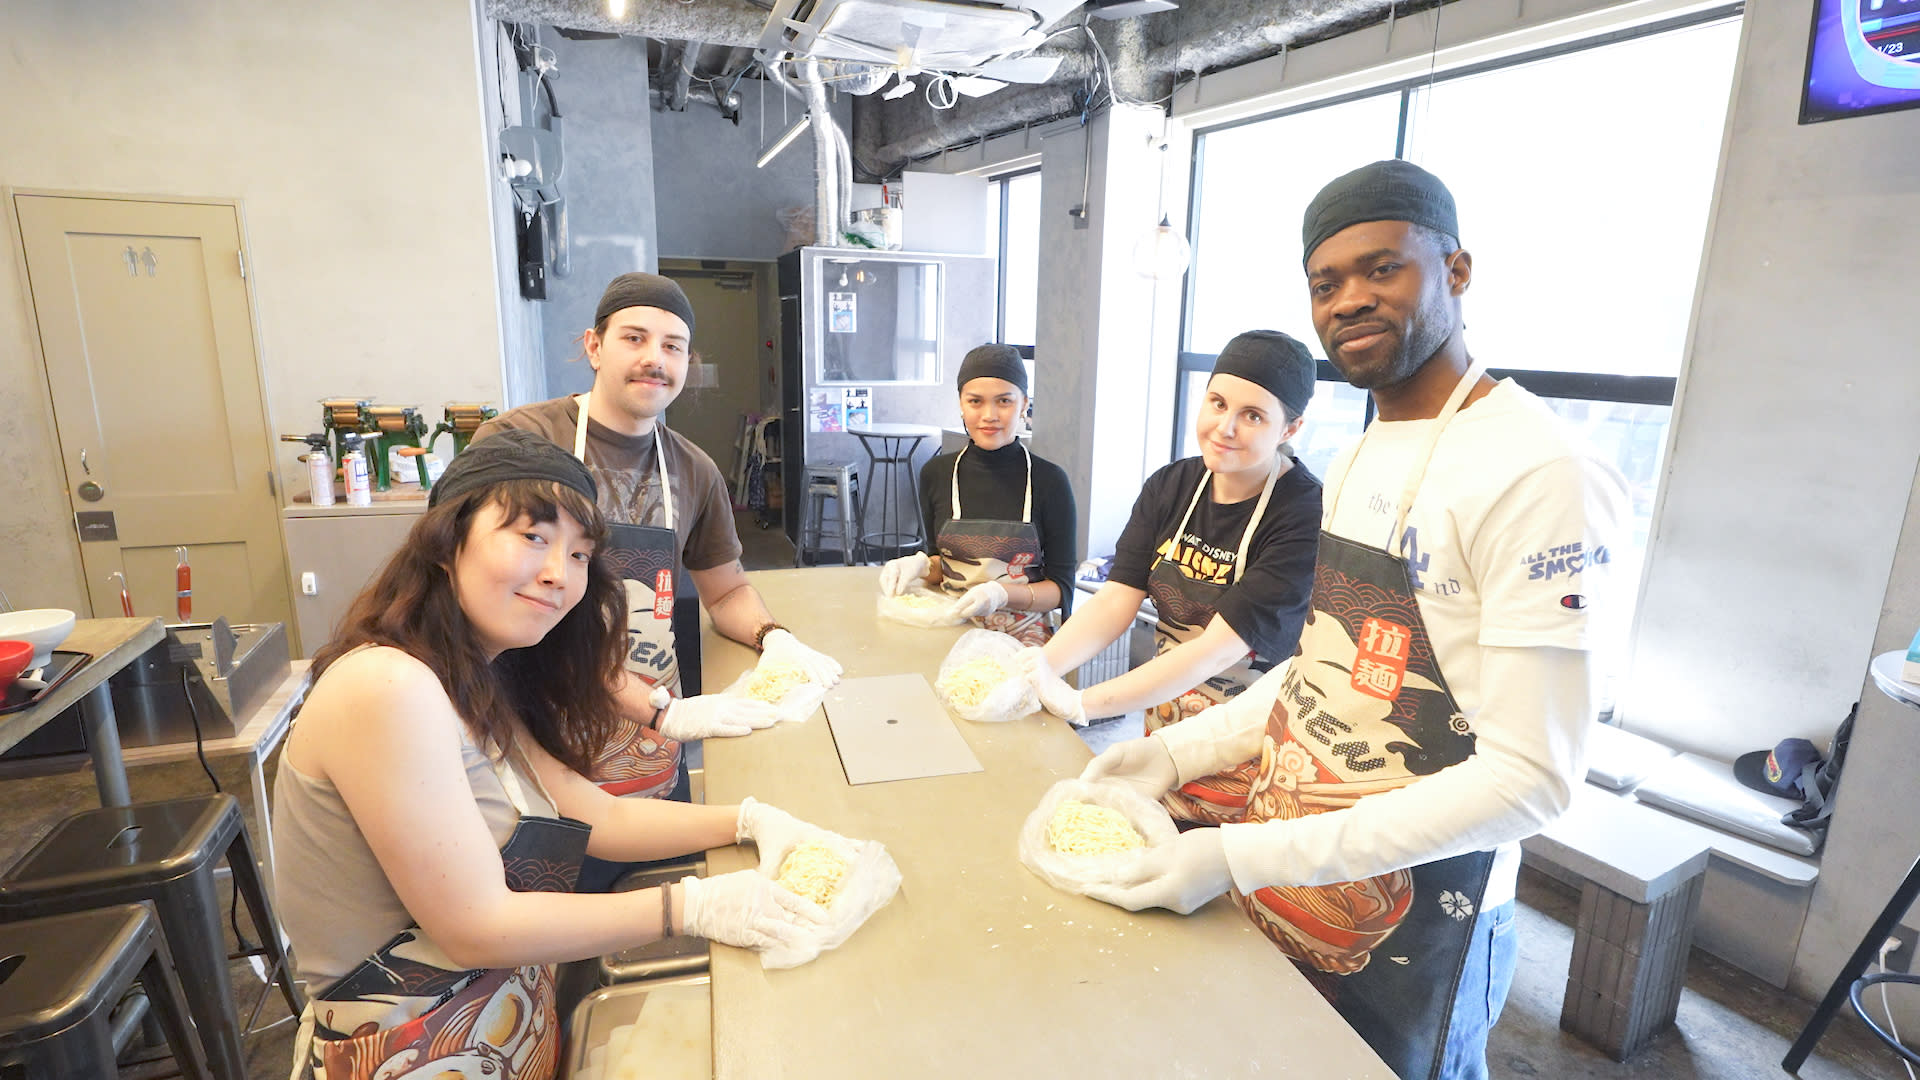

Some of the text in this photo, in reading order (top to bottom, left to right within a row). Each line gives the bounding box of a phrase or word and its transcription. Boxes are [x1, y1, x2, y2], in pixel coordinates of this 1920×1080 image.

[1202, 544, 1238, 563] DISNEY
[1520, 541, 1583, 565] ALL THE
